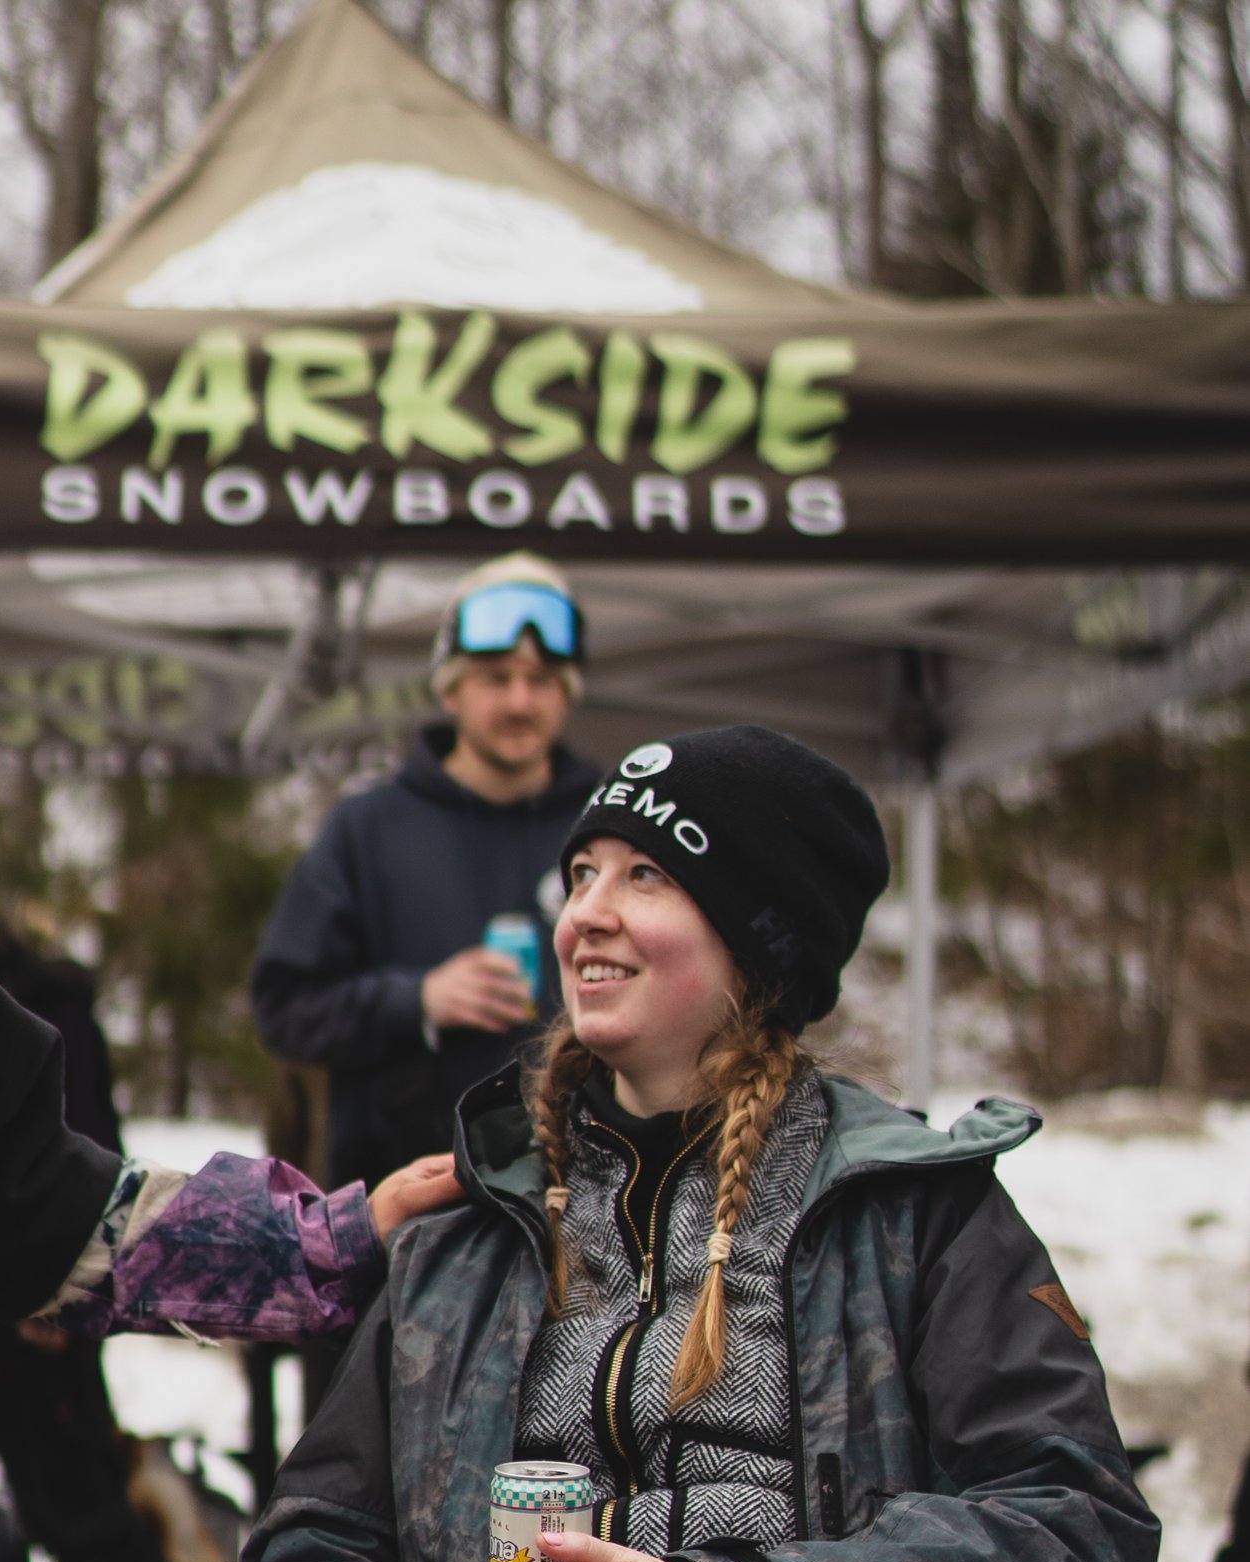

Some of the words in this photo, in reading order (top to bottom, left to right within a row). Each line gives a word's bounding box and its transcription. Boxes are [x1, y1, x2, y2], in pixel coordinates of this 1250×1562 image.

[37, 309, 857, 475] DARKSIDE
[41, 464, 847, 536] SNOWBOARDS
[543, 1489, 565, 1500] 21+
